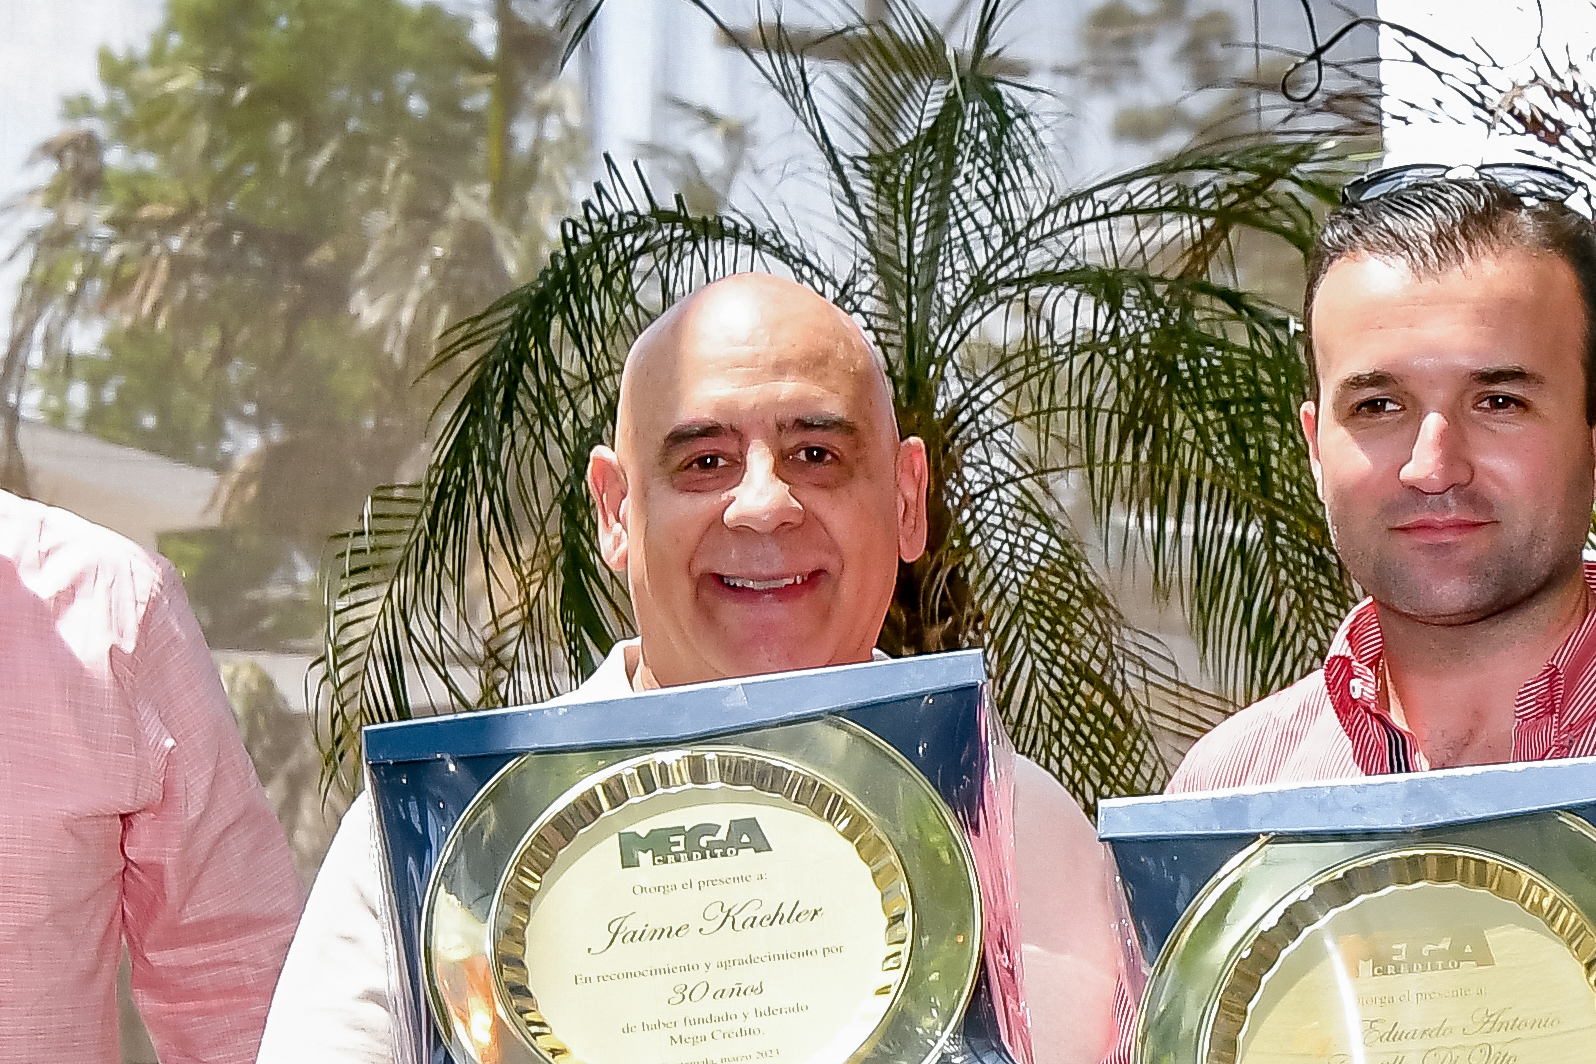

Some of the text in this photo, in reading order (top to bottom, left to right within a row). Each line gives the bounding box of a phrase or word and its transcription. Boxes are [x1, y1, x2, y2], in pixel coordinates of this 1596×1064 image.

[618, 817, 773, 869] MEGA
[632, 872, 767, 895] Otorga el presente a:
[587, 911, 690, 956] Jaime
[574, 945, 844, 986] En reconocimiento y agradecimiento por
[668, 980, 764, 1006] 30 años
[1356, 995, 1395, 1008] torga
[1398, 990, 1411, 1002] el
[1415, 987, 1471, 1004] presente
[621, 1003, 809, 1034] de haber fundado y liderado
[1362, 1007, 1562, 1047] Eduardo Antonio
[669, 1034, 707, 1046] Mega
[720, 1054, 752, 1064] marzo
